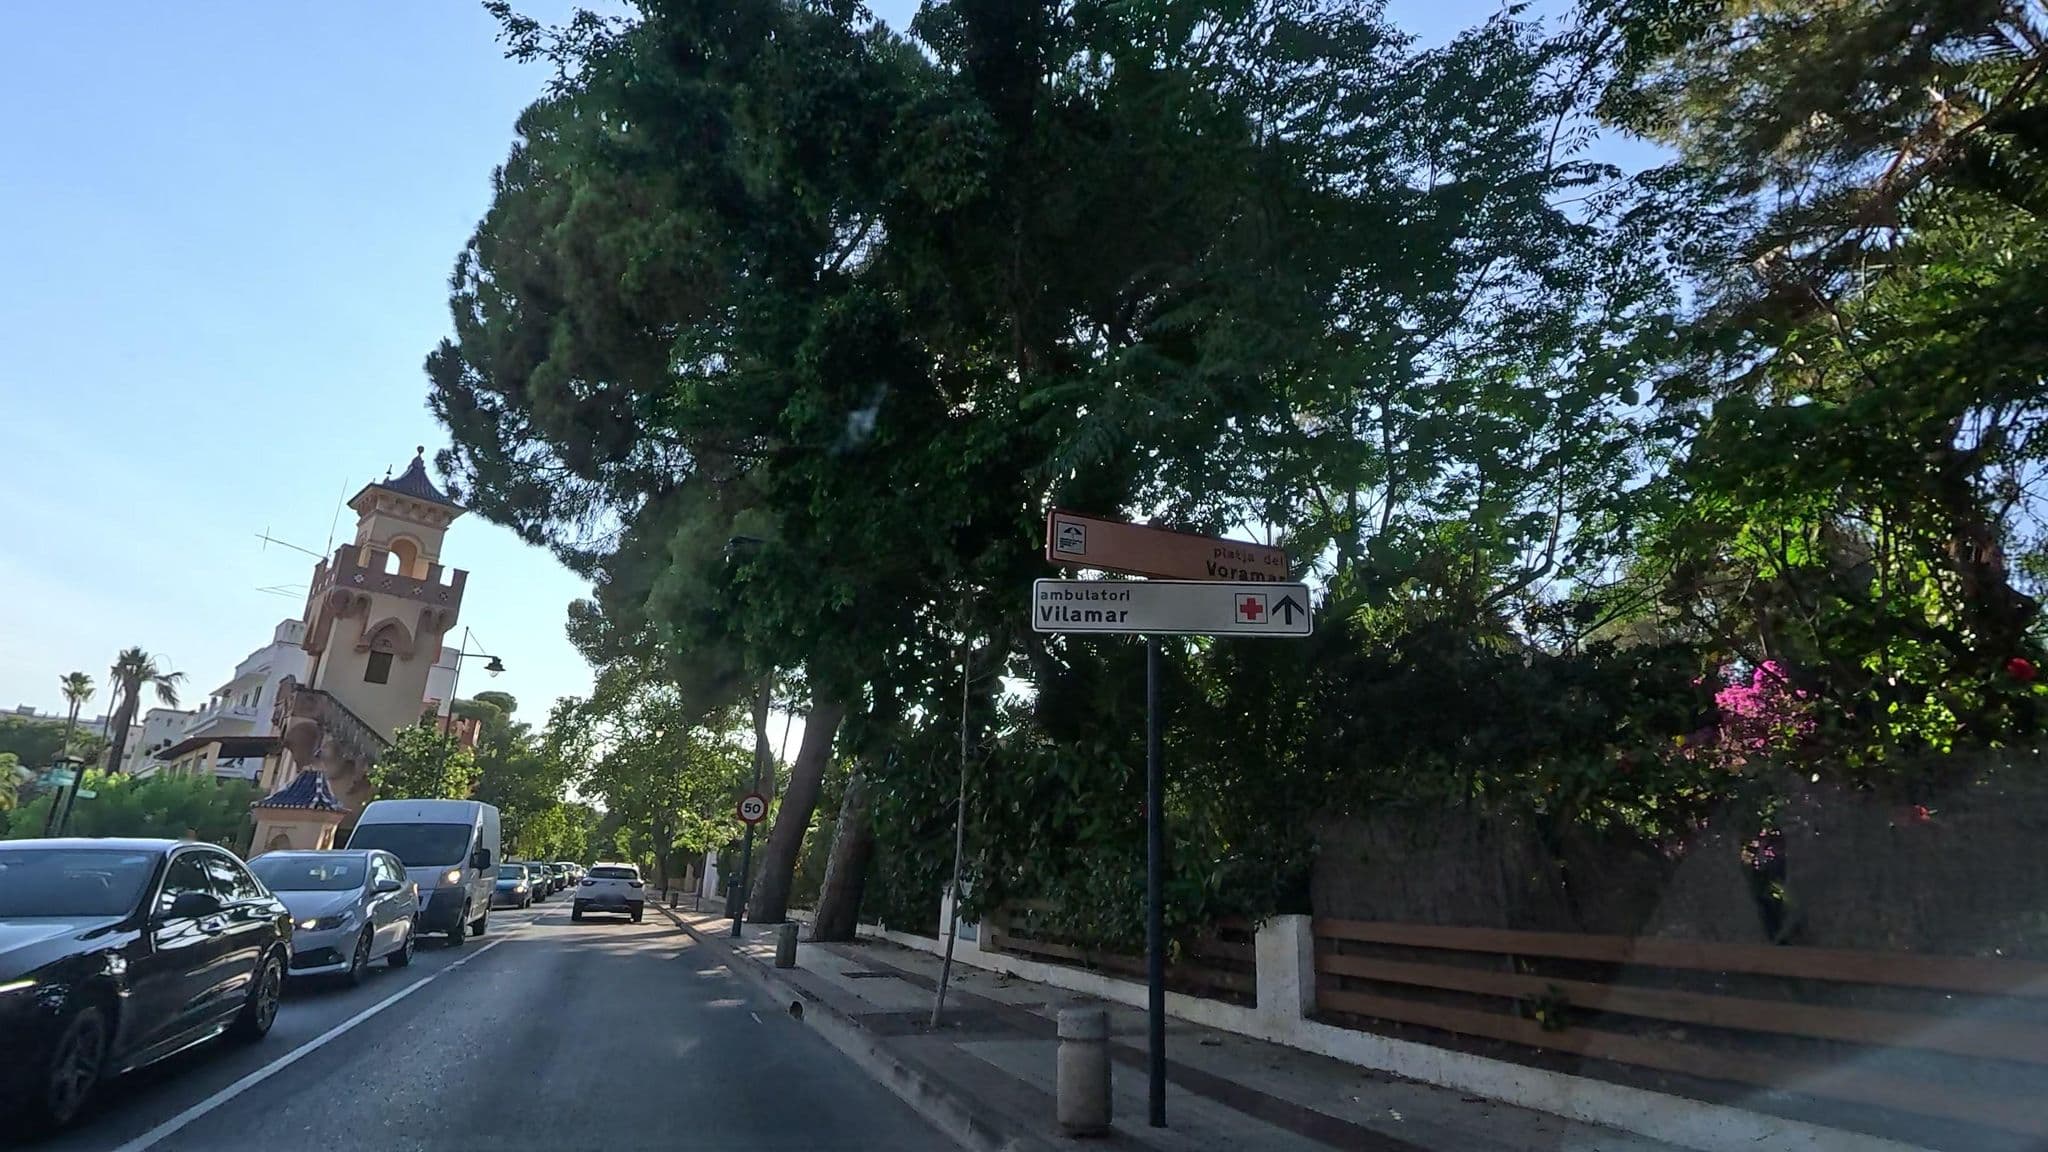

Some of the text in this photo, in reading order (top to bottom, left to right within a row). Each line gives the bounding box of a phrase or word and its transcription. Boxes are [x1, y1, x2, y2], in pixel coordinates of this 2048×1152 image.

[1214, 547, 1284, 567] platja del
[1040, 589, 1130, 601] ambulatori
[1040, 605, 1129, 623] Vilamar
[744, 802, 761, 814] 50
